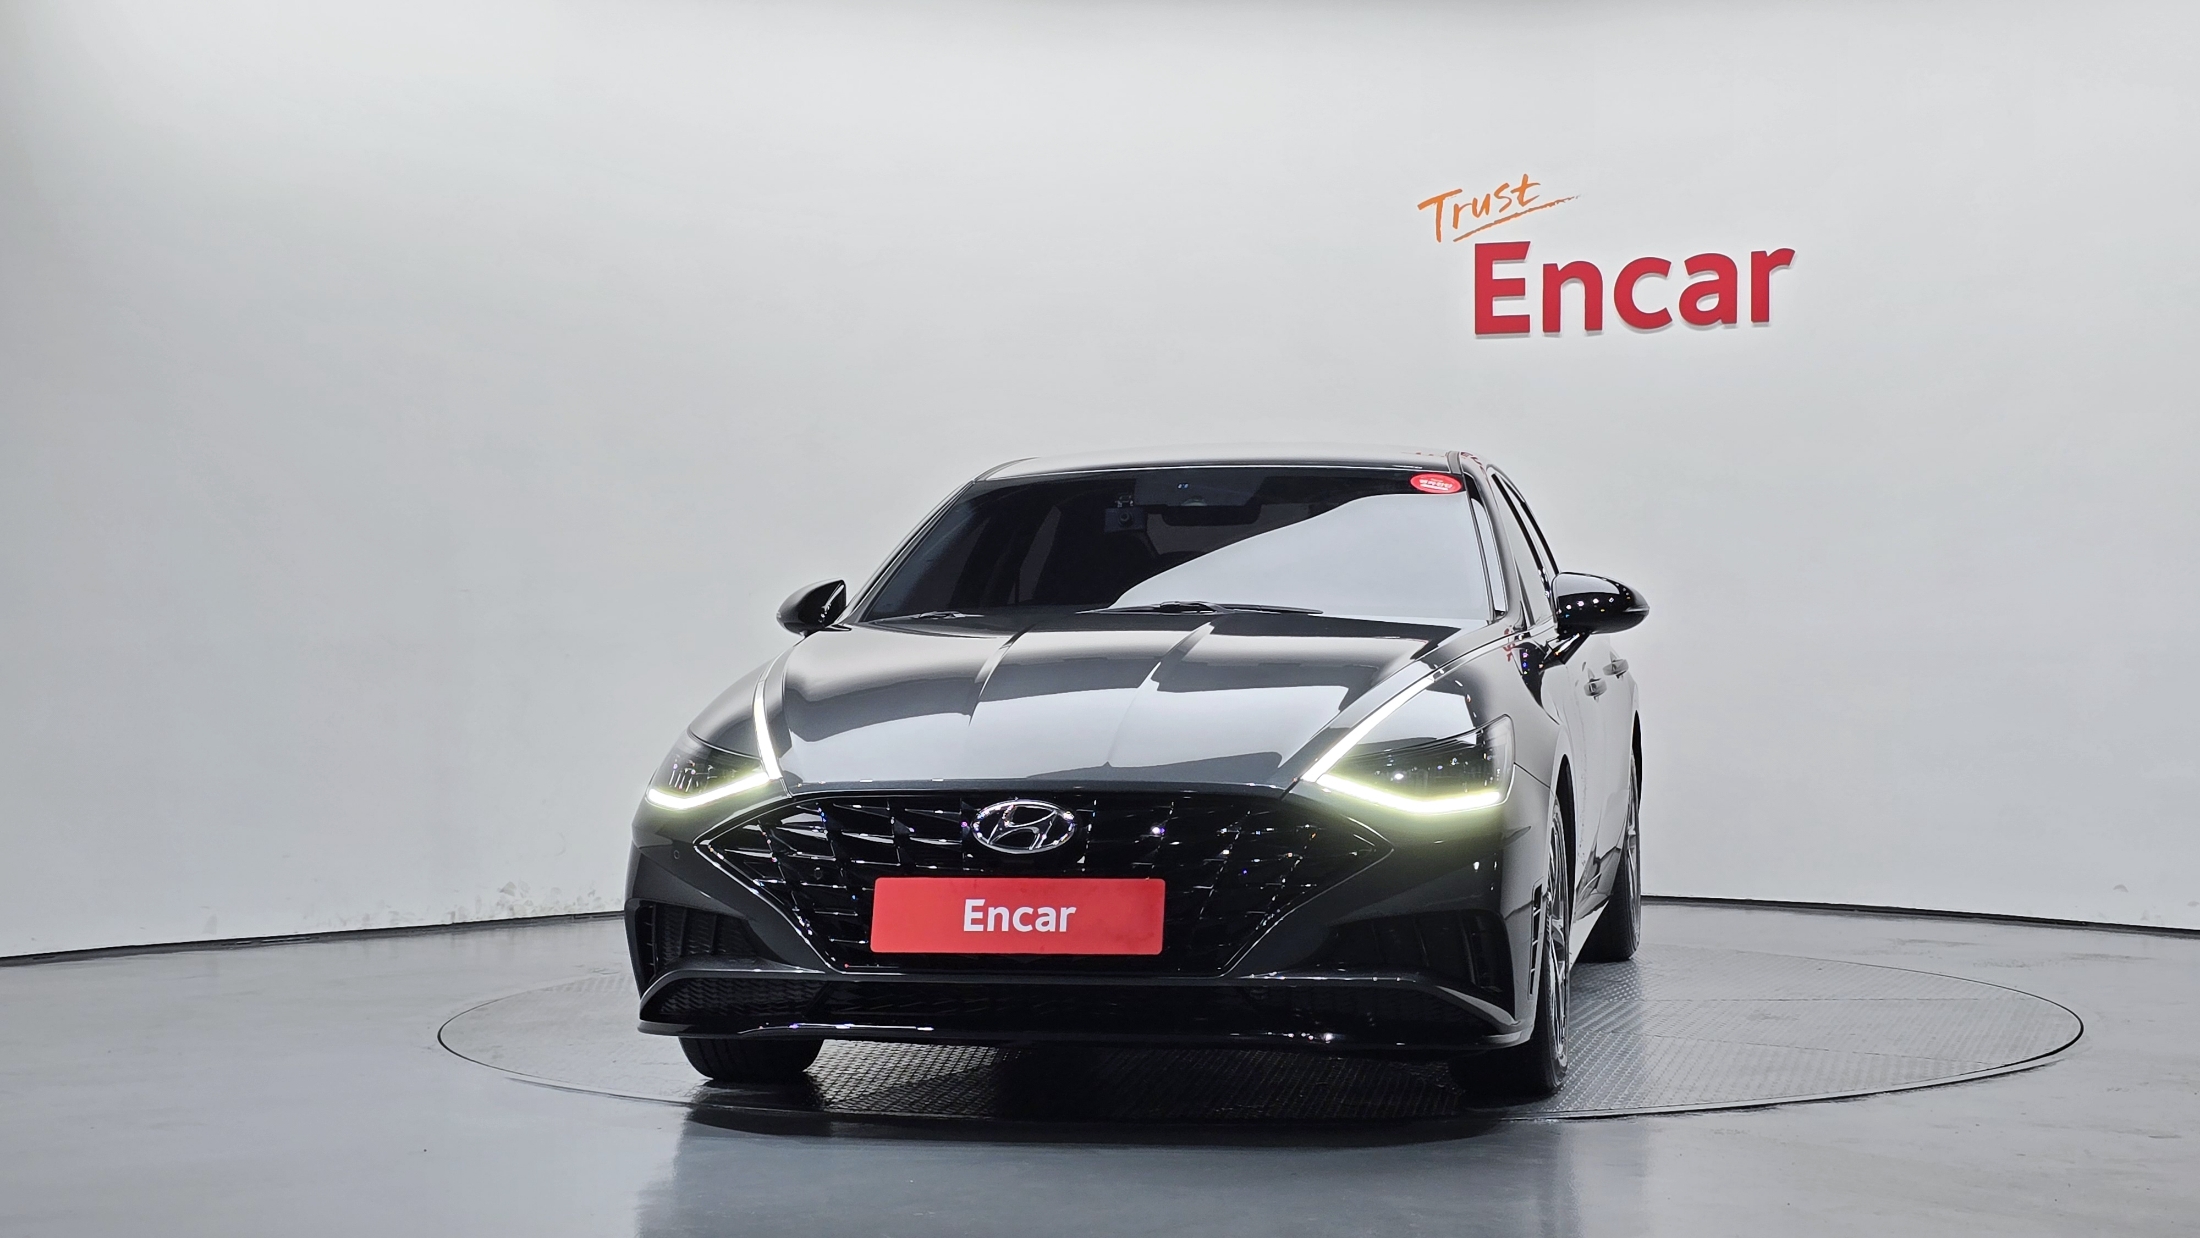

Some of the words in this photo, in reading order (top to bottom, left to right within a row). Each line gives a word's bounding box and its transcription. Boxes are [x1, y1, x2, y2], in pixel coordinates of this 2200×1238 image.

[1417, 173, 1541, 243] Trust
[1474, 241, 1796, 335] Encar
[963, 898, 1077, 933] Encar
